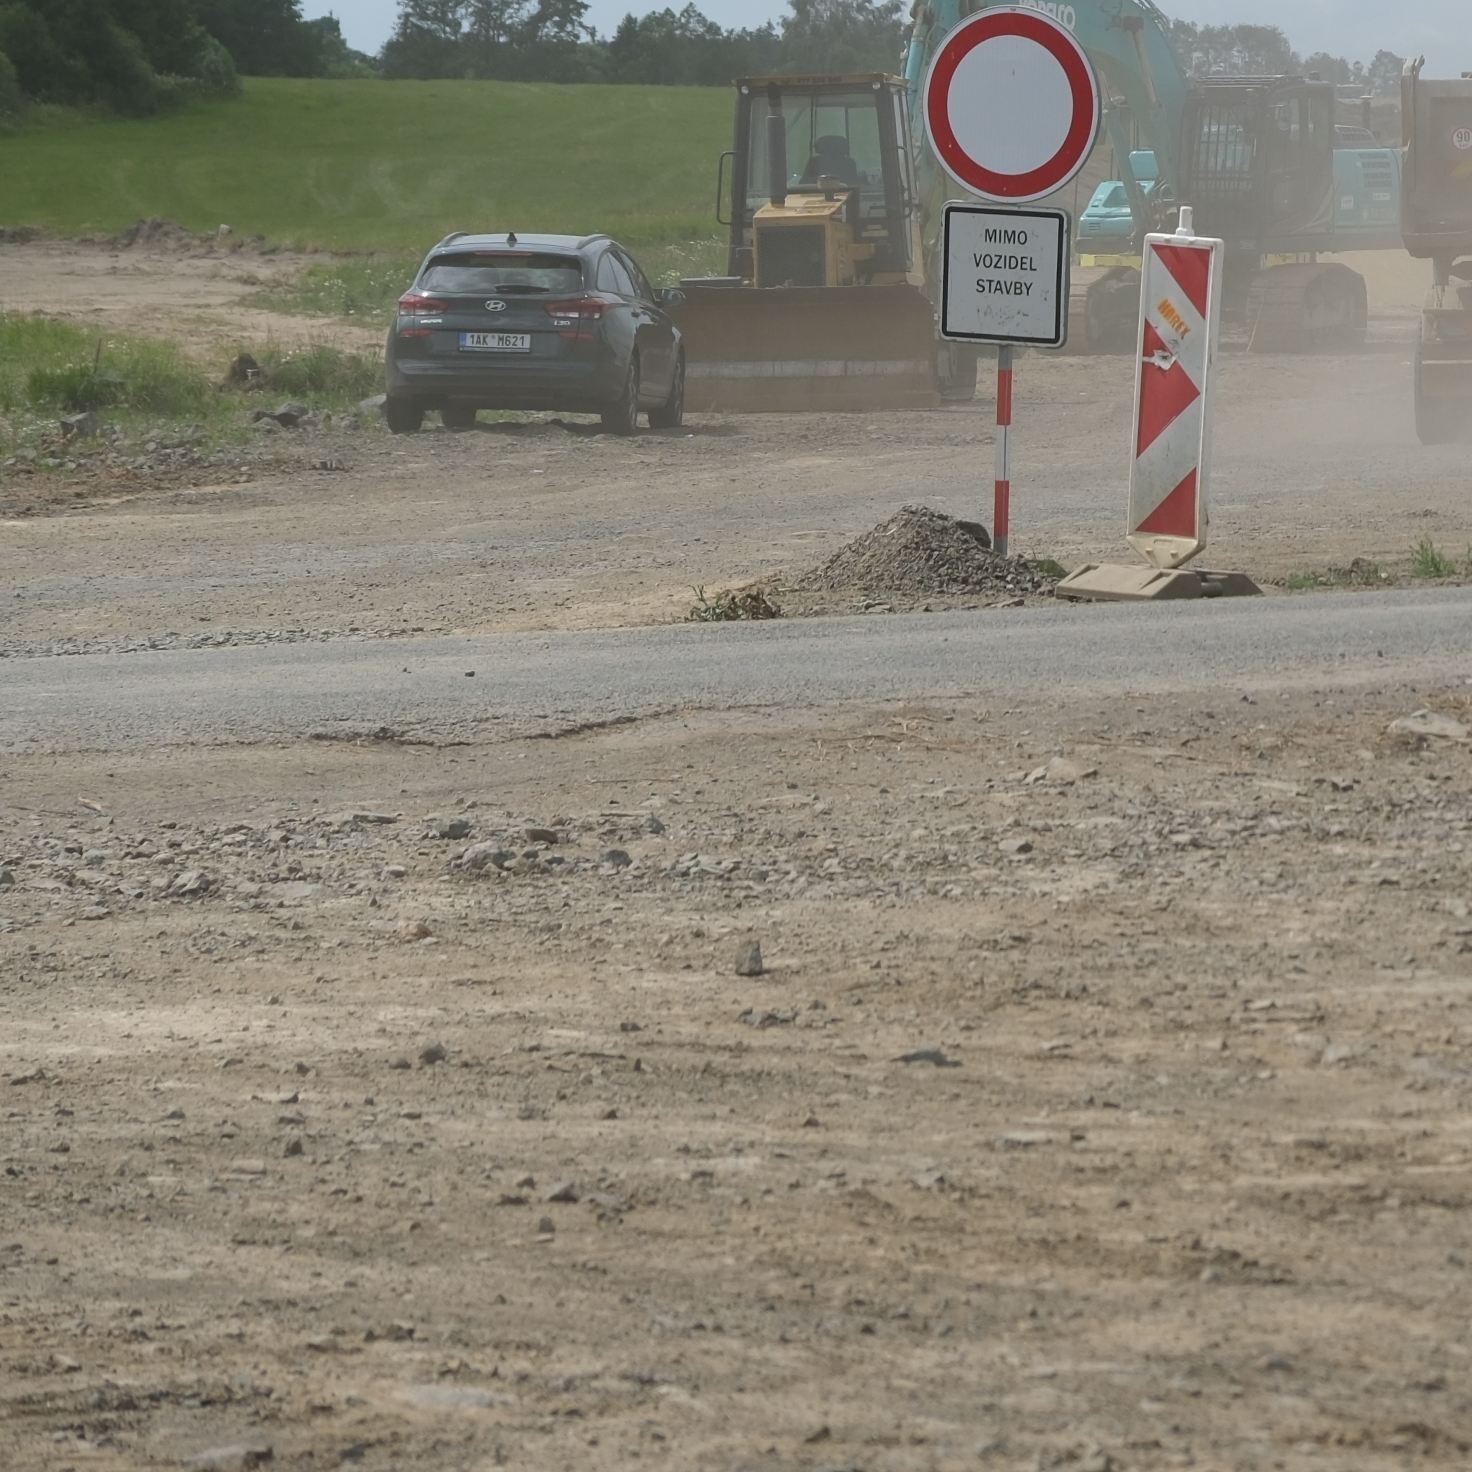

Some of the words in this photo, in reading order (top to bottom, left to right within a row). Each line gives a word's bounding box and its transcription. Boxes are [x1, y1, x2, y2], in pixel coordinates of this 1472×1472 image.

[1456, 131, 1471, 142] 90
[984, 228, 1028, 245] MIMO
[973, 253, 1037, 271] VOZIDEL
[976, 278, 1033, 297] STAVBY
[469, 334, 488, 346] 1AK
[497, 335, 525, 347] M621
